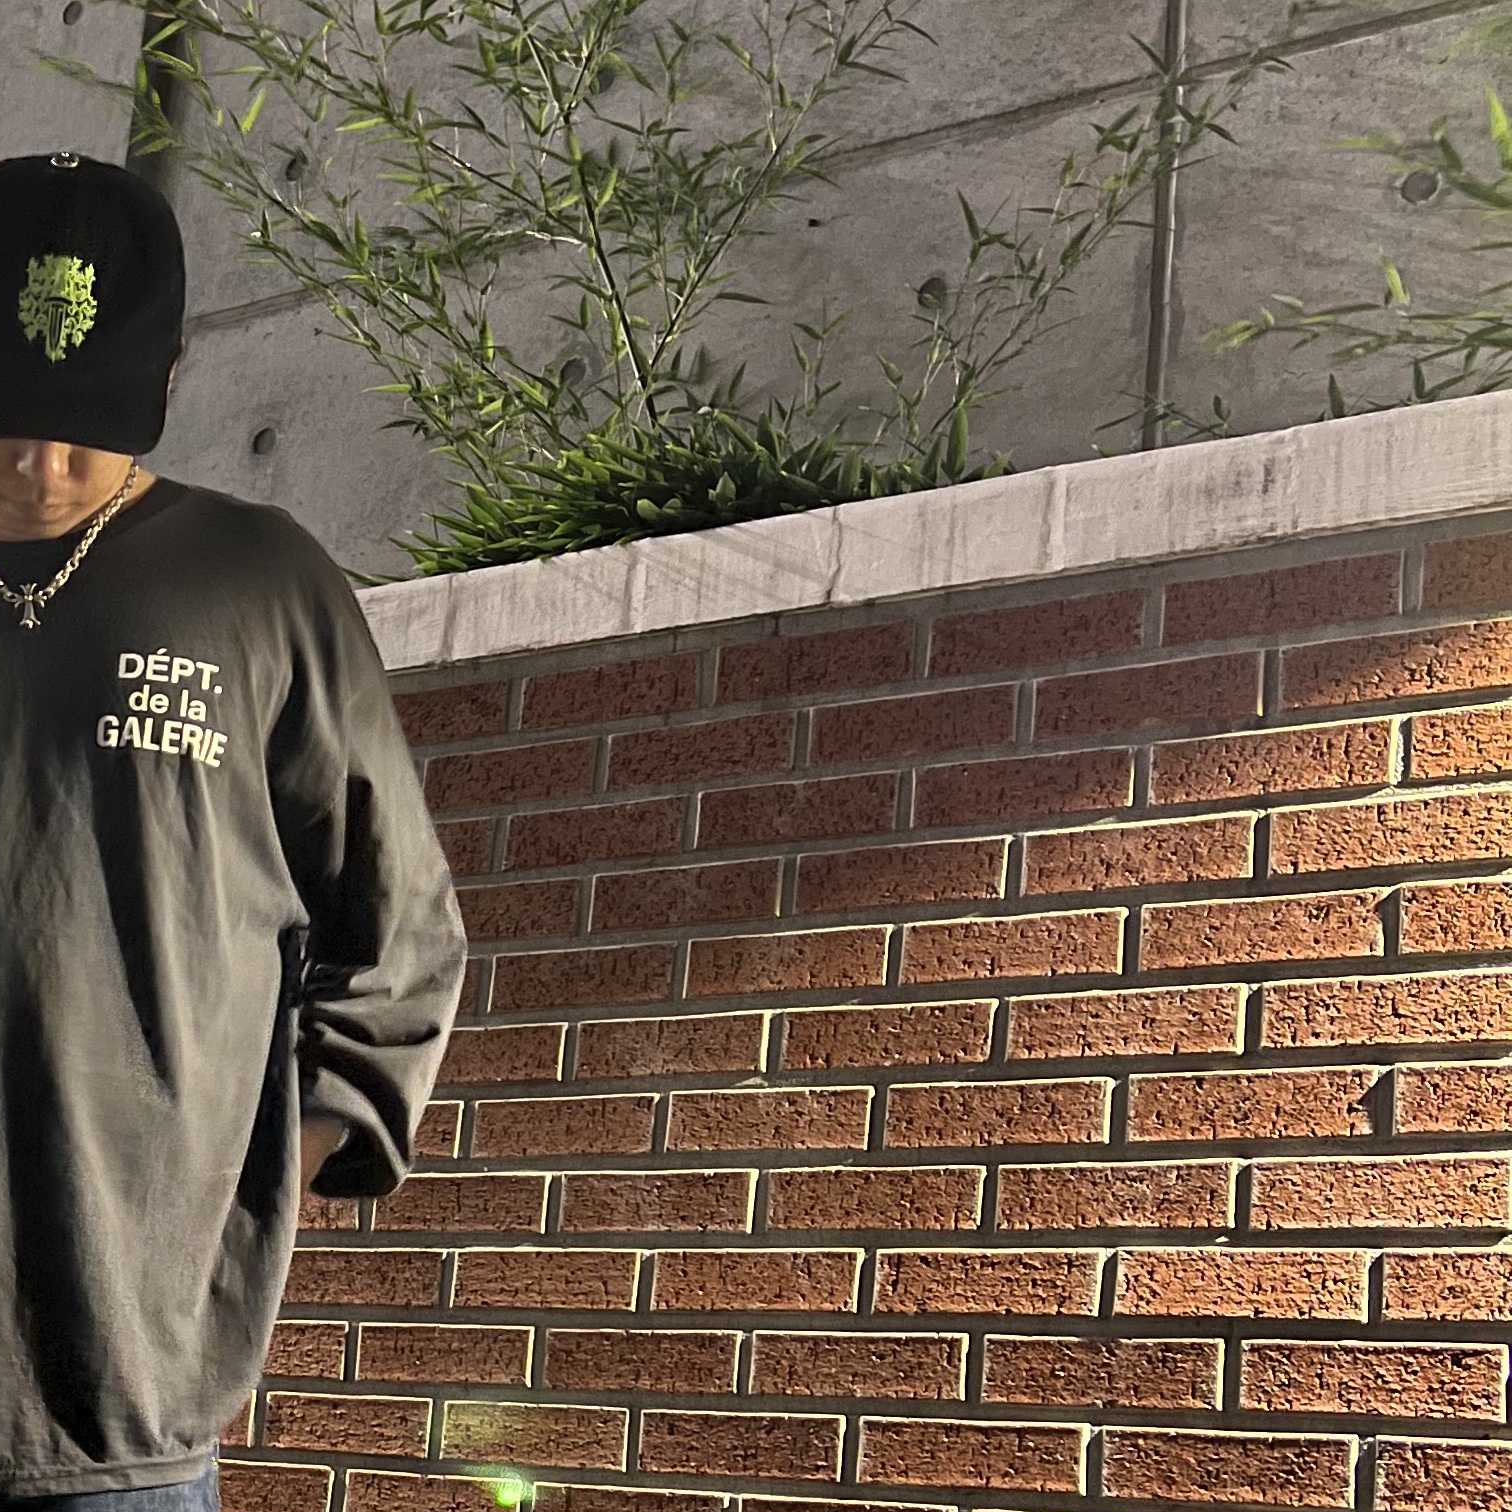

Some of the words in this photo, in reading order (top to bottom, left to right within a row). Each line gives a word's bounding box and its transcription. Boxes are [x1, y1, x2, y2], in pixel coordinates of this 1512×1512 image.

[117, 647, 223, 694] DÉPT.
[128, 684, 170, 714] de
[179, 689, 207, 722] la
[96, 714, 228, 768] GALERIE
